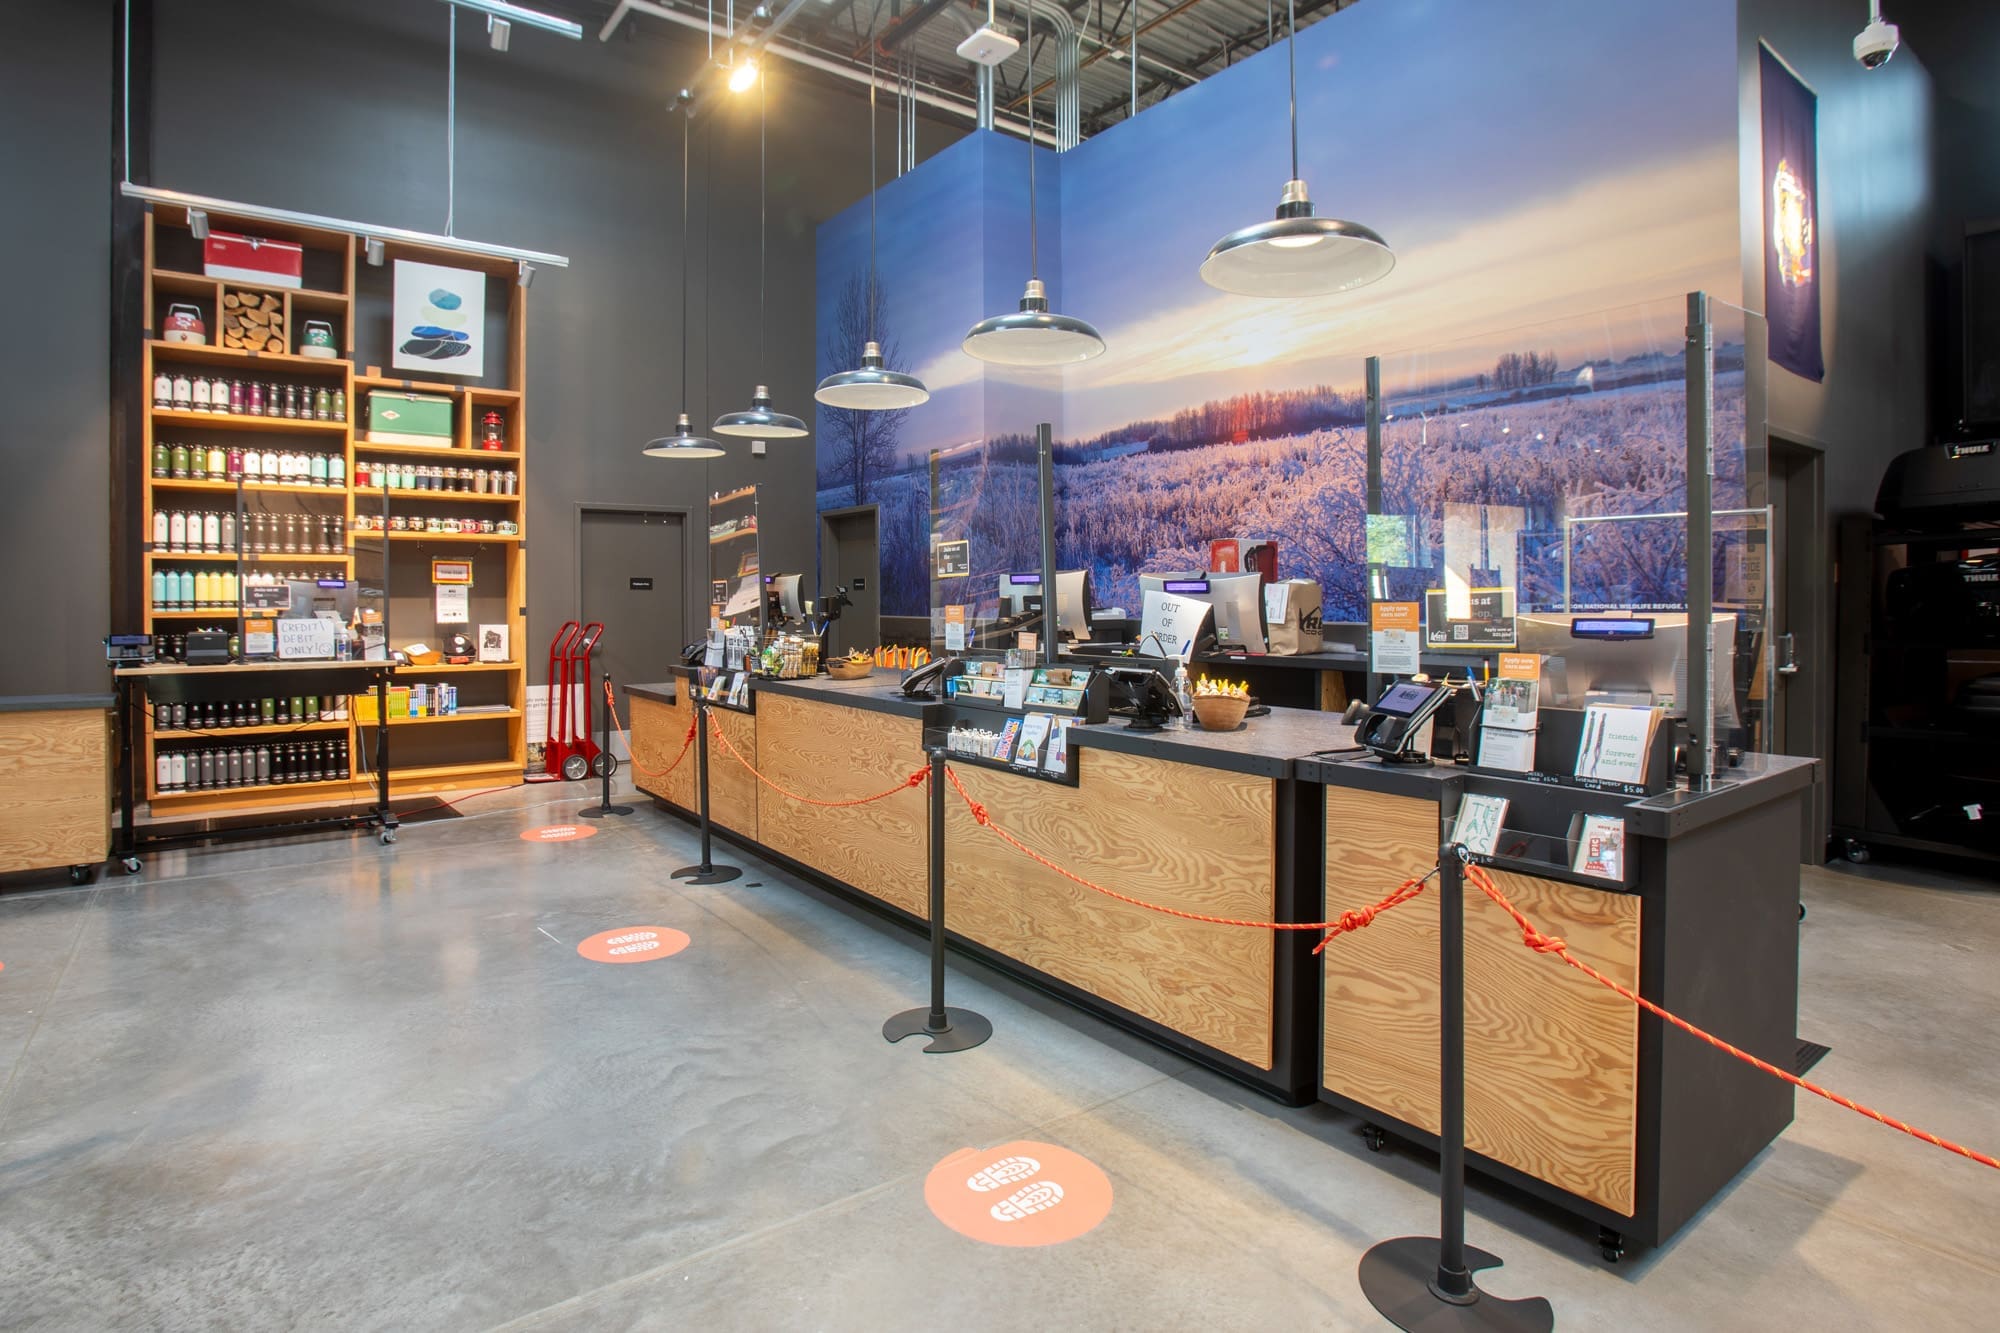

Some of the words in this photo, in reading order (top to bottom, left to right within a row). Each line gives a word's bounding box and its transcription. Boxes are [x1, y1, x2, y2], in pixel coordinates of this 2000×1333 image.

[1955, 444, 1989, 455] THULE
[1964, 574, 2000, 582] THULE
[1161, 602, 1180, 612] OUT
[1162, 618, 1174, 627] OF
[283, 634, 314, 644] DEBIT
[1608, 733, 1638, 741] friends
[1606, 748, 1636, 758] forever
[1623, 784, 1644, 794] $5.00
[1591, 838, 1600, 857] EPIC
